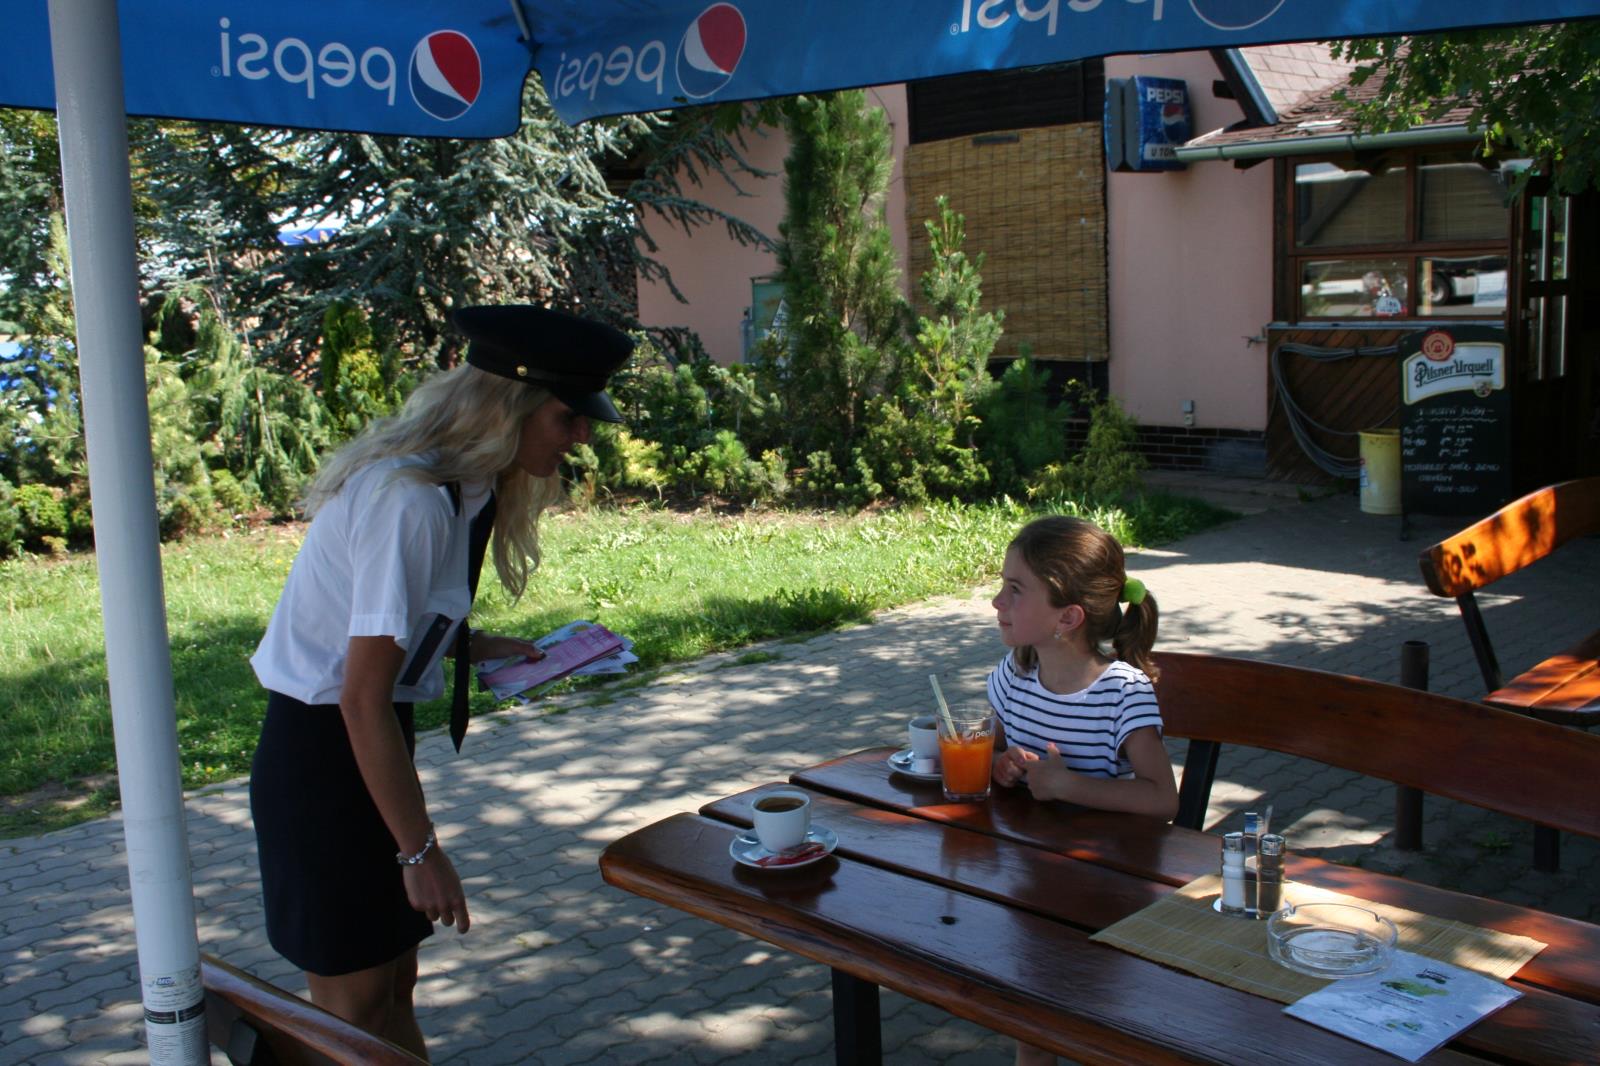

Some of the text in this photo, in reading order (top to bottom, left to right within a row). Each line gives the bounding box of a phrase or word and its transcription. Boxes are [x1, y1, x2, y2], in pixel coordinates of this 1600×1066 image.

[1146, 87, 1184, 104] PEPSI
[1414, 359, 1493, 387] Pilsner Urquell
